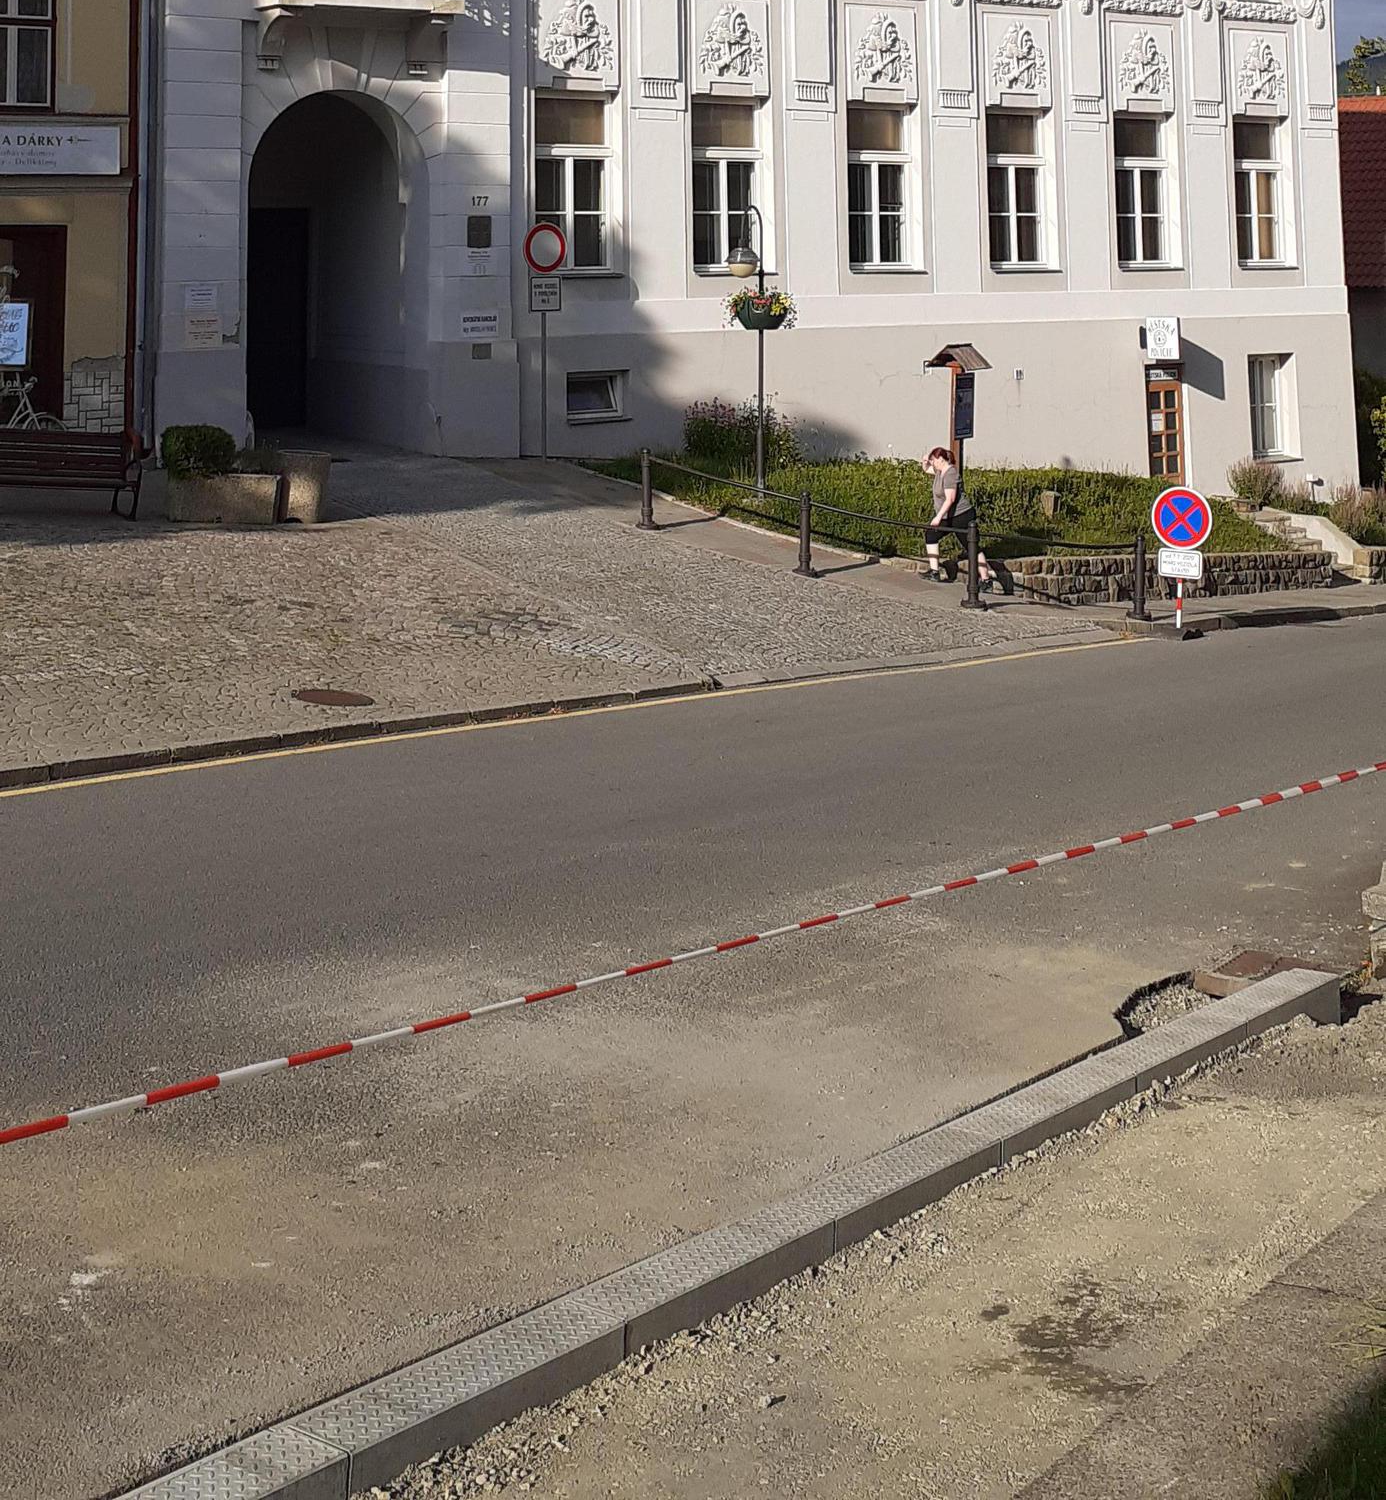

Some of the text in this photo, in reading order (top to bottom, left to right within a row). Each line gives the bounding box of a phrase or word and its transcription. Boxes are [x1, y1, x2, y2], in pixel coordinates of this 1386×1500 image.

[2, 132, 63, 146] A DÁRKY
[472, 196, 489, 206] 177
